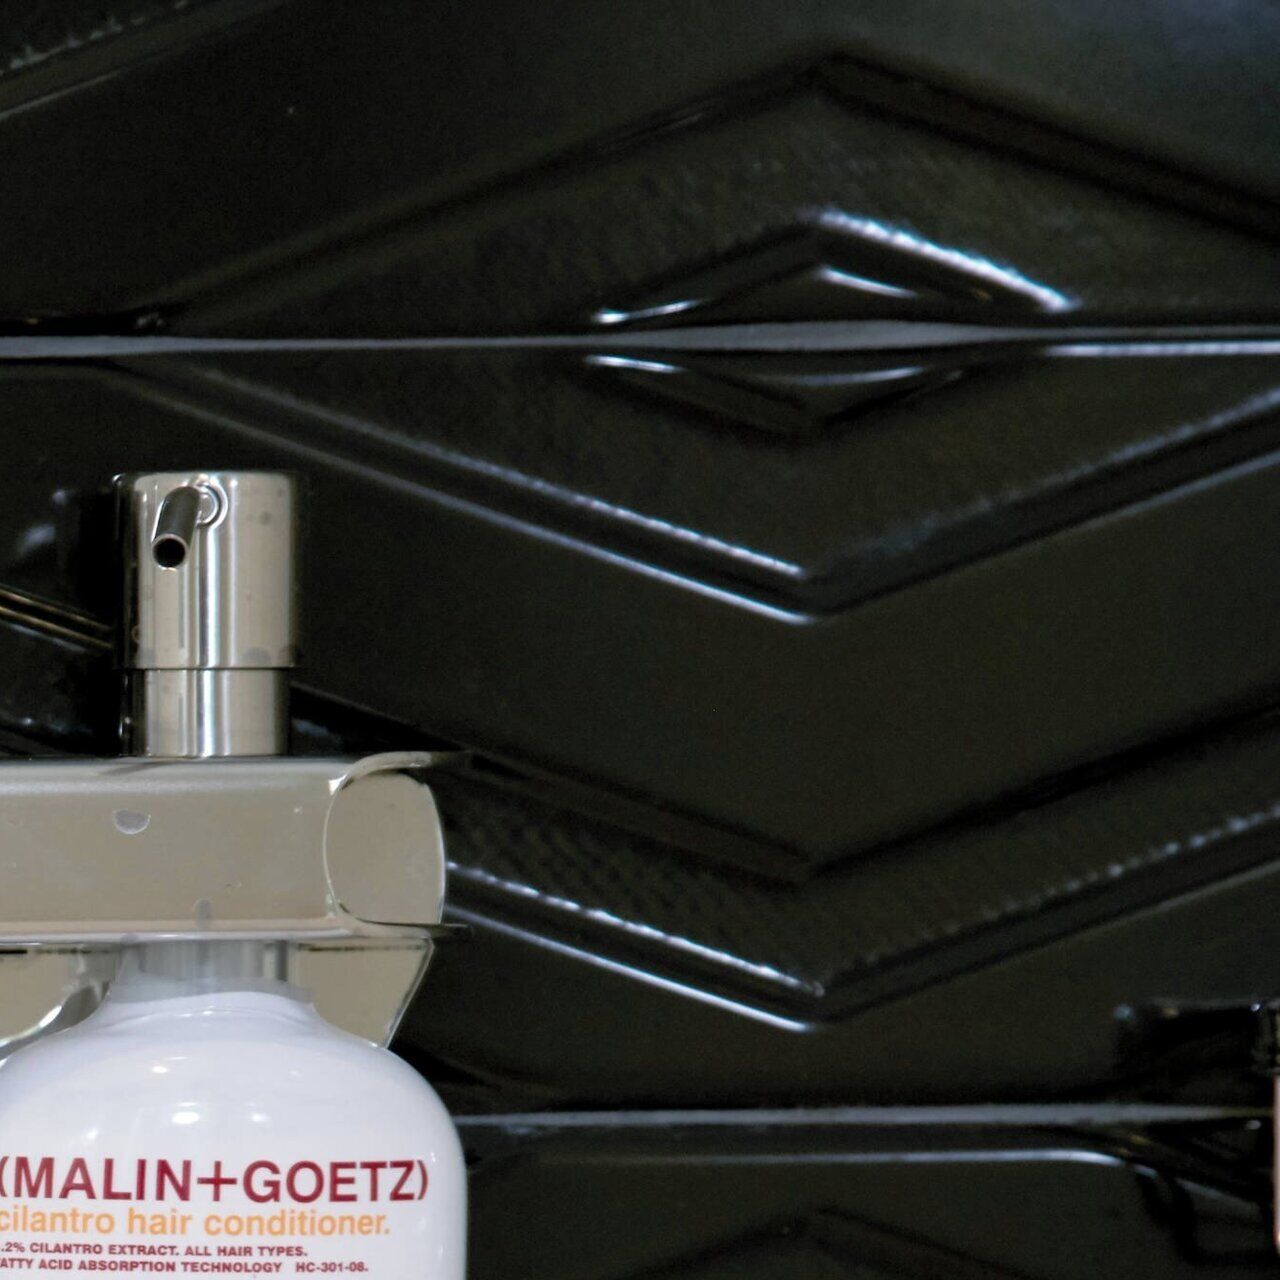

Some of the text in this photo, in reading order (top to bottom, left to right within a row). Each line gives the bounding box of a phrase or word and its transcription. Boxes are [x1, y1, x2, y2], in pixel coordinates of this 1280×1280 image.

[127, 1208, 192, 1236] hair
[204, 1209, 390, 1237] conditioner.
[29, 1242, 103, 1255] CILANTRO
[108, 1244, 179, 1256] EXTRACT.
[184, 1245, 212, 1257] ALL
[217, 1246, 252, 1257] HAIR
[257, 1246, 308, 1257] TYPES.
[38, 1259, 73, 1270] ACID
[77, 1260, 176, 1272] ABSORPTION
[181, 1261, 283, 1273] TECHNOLOGY
